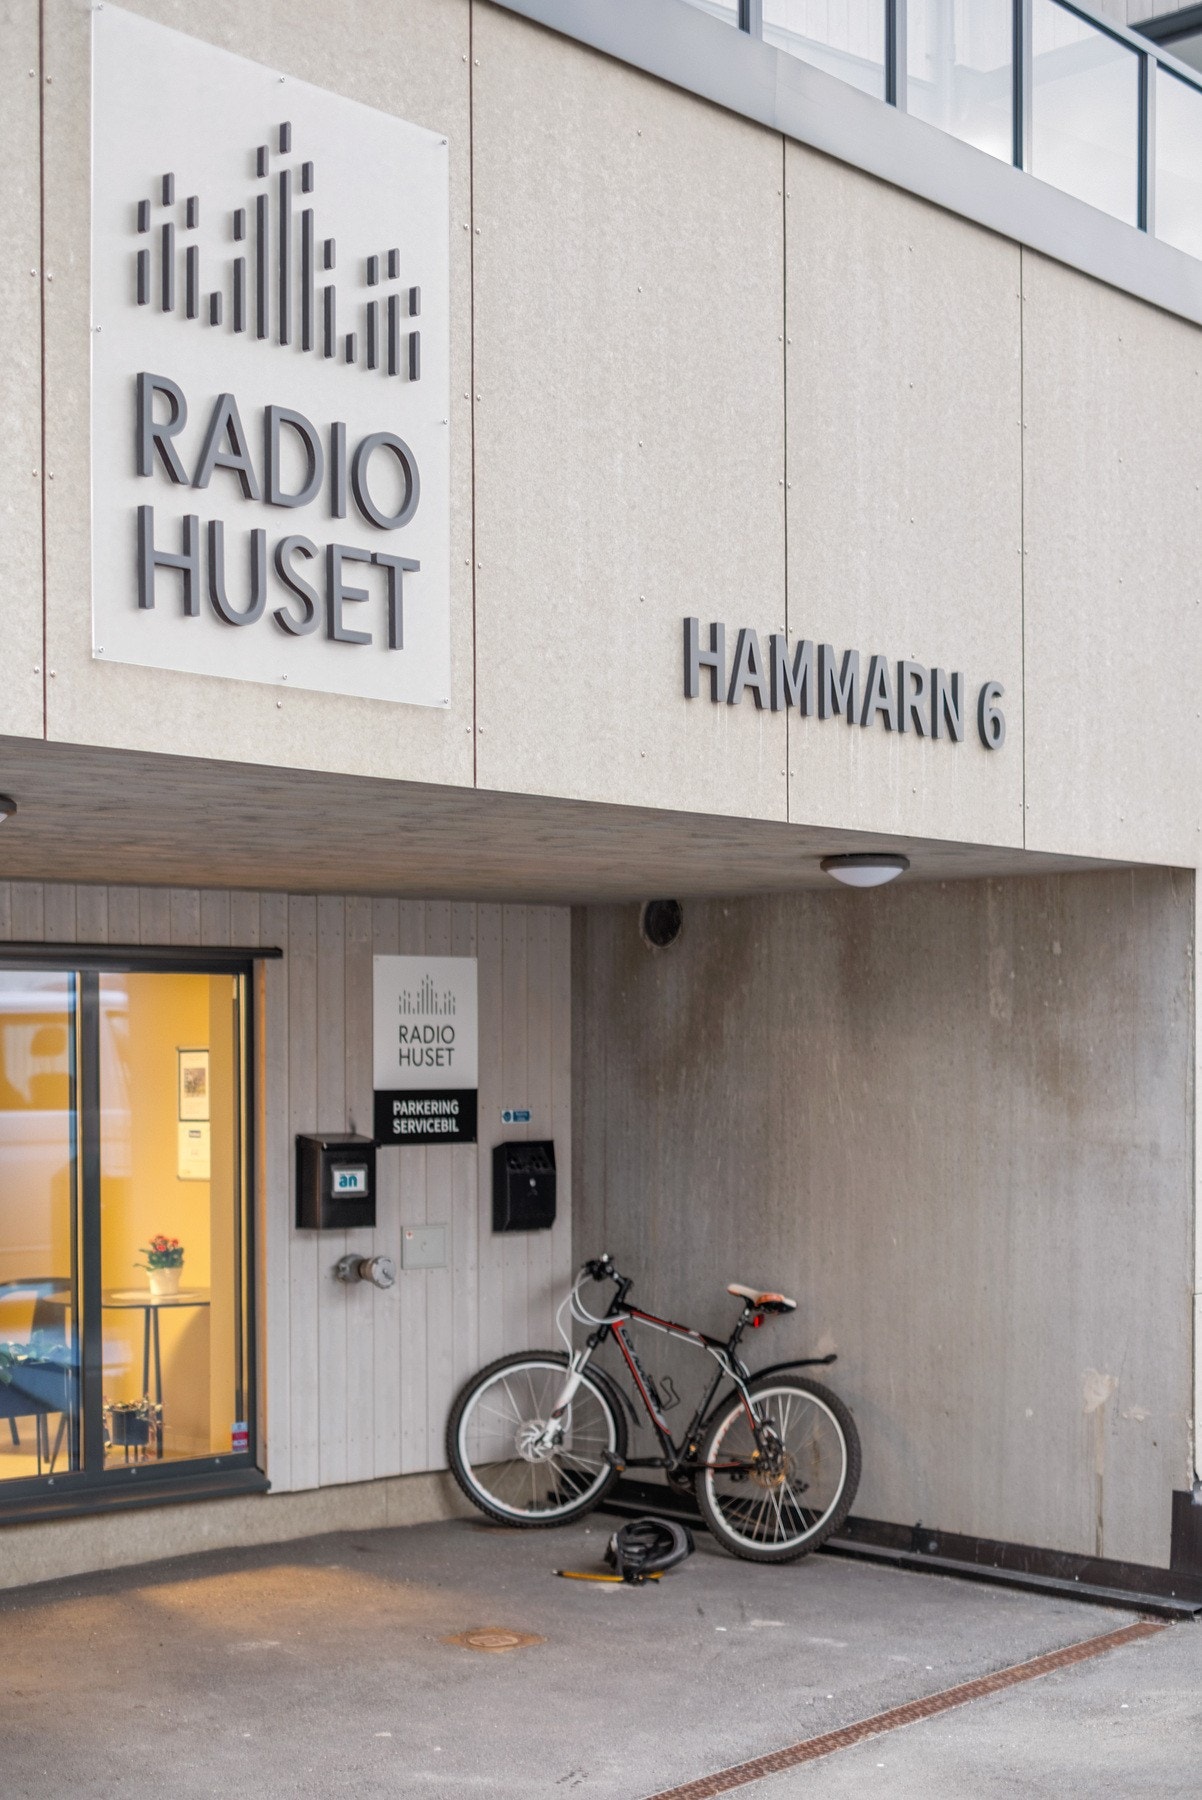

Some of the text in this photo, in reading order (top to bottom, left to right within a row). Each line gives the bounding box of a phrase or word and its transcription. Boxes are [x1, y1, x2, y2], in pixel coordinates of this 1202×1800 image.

[137, 371, 420, 530] RADIO
[137, 505, 420, 651] HUSET
[683, 617, 1006, 750] HAMMARN 6
[399, 1025, 455, 1044] RADIO
[399, 1048, 455, 1066] HUSET
[393, 1100, 459, 1116] PARKERING
[393, 1118, 459, 1133] SERVICEBIL
